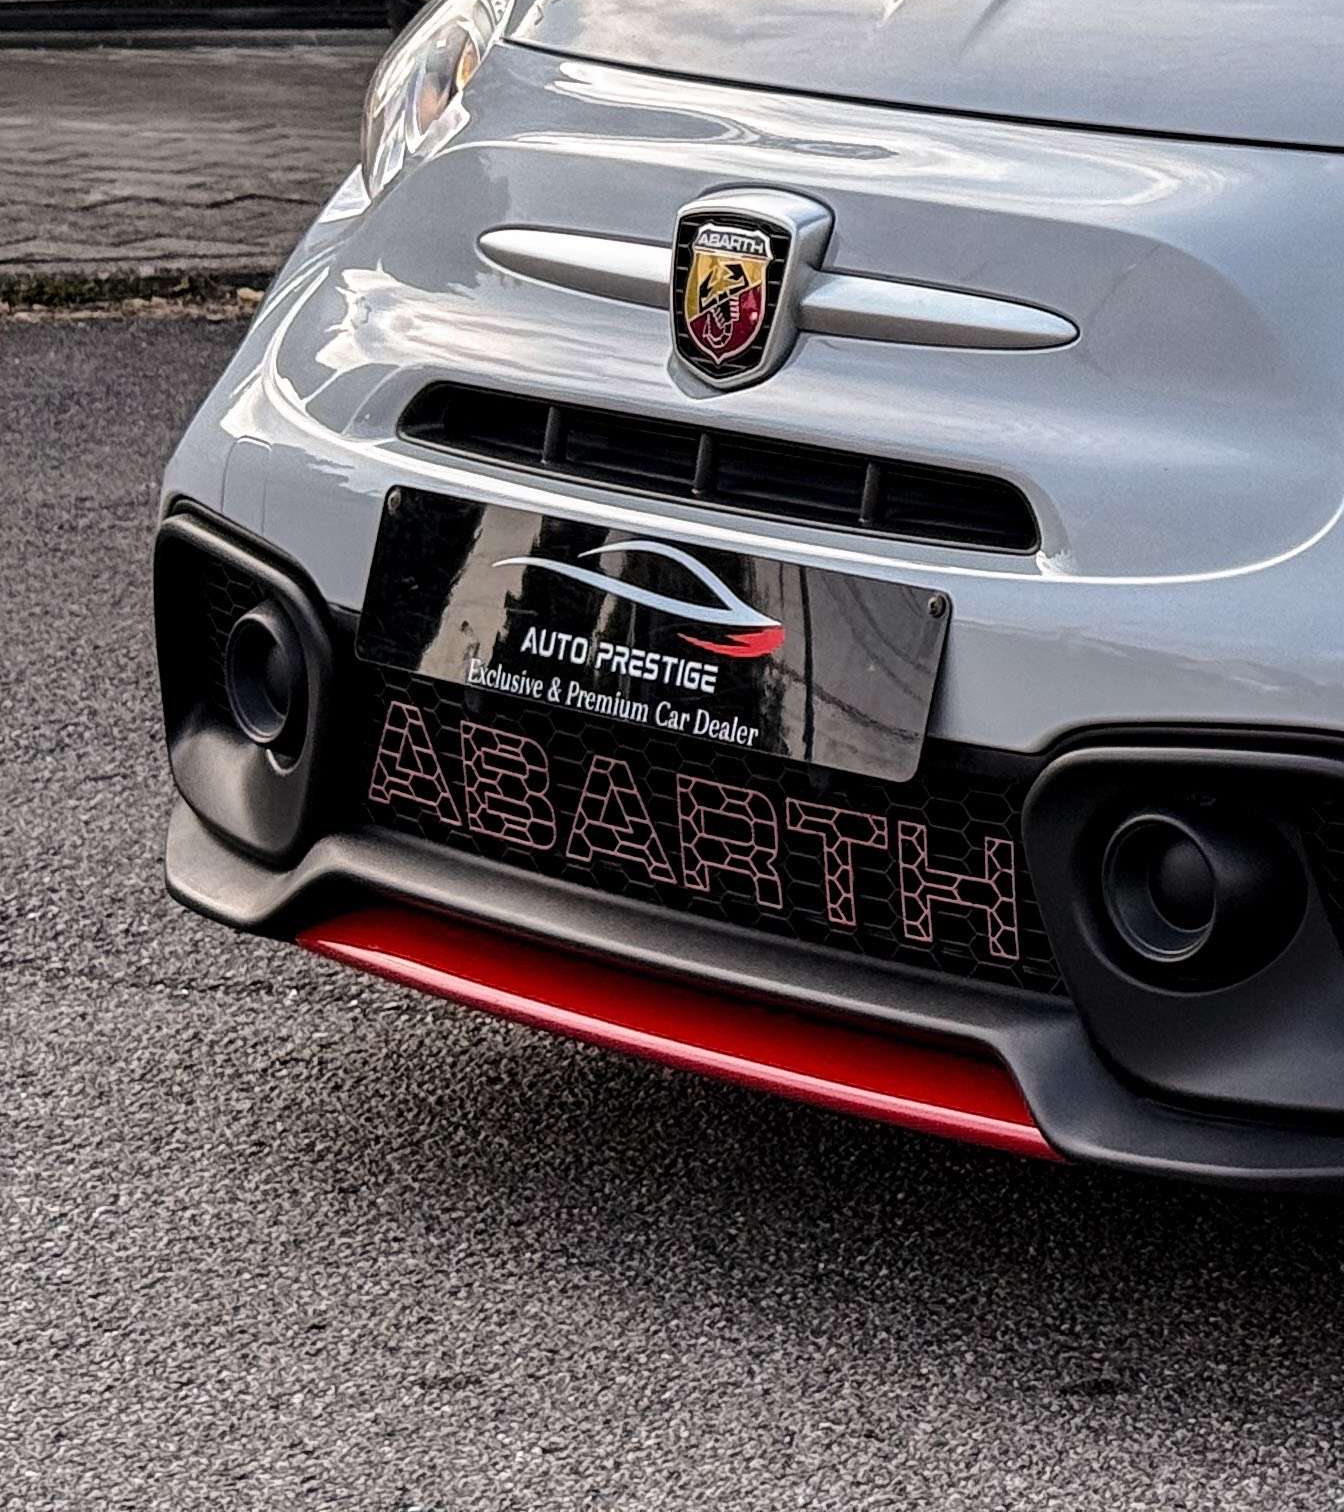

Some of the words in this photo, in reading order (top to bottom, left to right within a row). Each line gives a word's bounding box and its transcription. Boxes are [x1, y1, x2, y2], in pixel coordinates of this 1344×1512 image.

[698, 233, 764, 253] ABARTH
[519, 625, 589, 666] AUTO
[594, 641, 719, 694] PRESTIGE
[466, 657, 544, 699] Exclusive
[546, 675, 562, 703] &
[566, 681, 649, 723] Premium
[655, 700, 691, 733] Car
[694, 708, 760, 748] Dealer
[367, 700, 1020, 961] ABARTH
